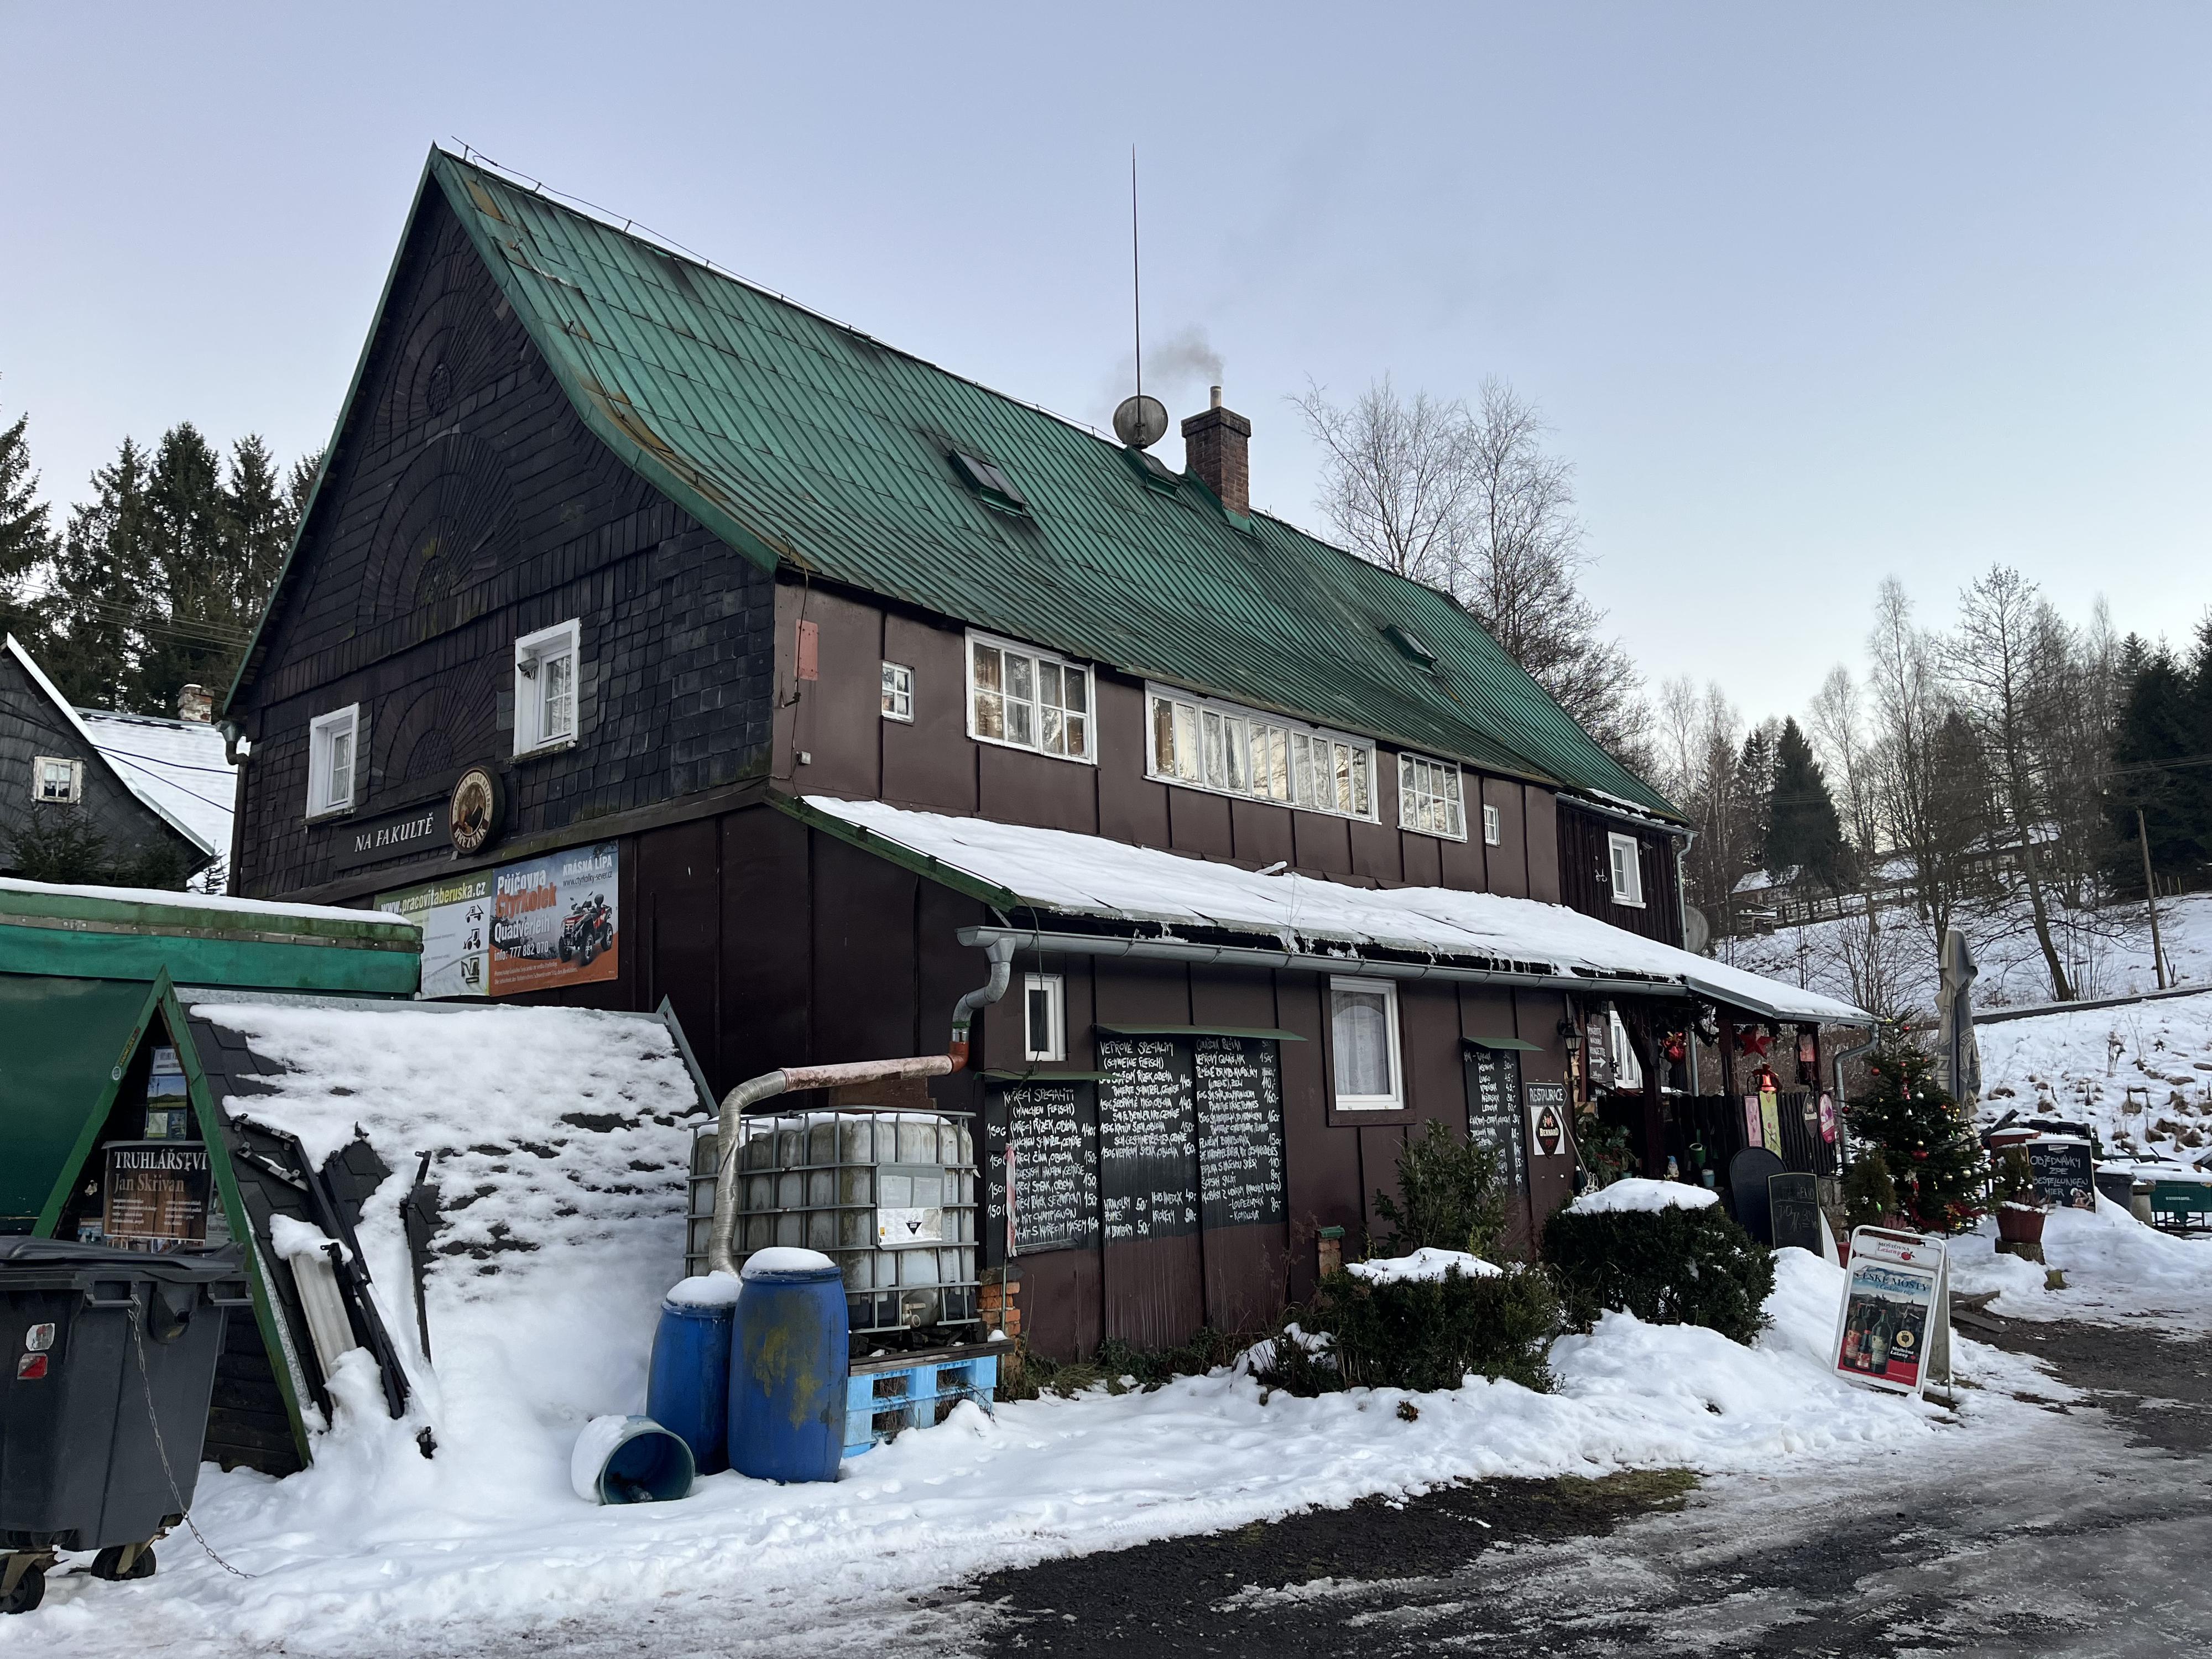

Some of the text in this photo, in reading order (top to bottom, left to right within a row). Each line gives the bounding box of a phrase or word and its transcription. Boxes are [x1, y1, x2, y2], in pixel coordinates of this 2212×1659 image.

[354, 811, 434, 852] NA FAKULTĚ
[563, 853, 613, 877] KRÁSNÁ LÍPA
[497, 869, 547, 896] Půjčovna
[494, 914, 551, 944] Quadverleih
[494, 941, 550, 962] info: 777 882 070
[1529, 1087, 1564, 1102] RESTAURACE
[1539, 1127, 1559, 1137] BERNARD
[114, 1149, 208, 1171] TRUHLÁŘSTVÍ
[114, 1173, 185, 1194] Jan Skřivan
[2032, 1176, 2089, 1187] BESTELLUNGEN
[2044, 1187, 2065, 1197] HIER
